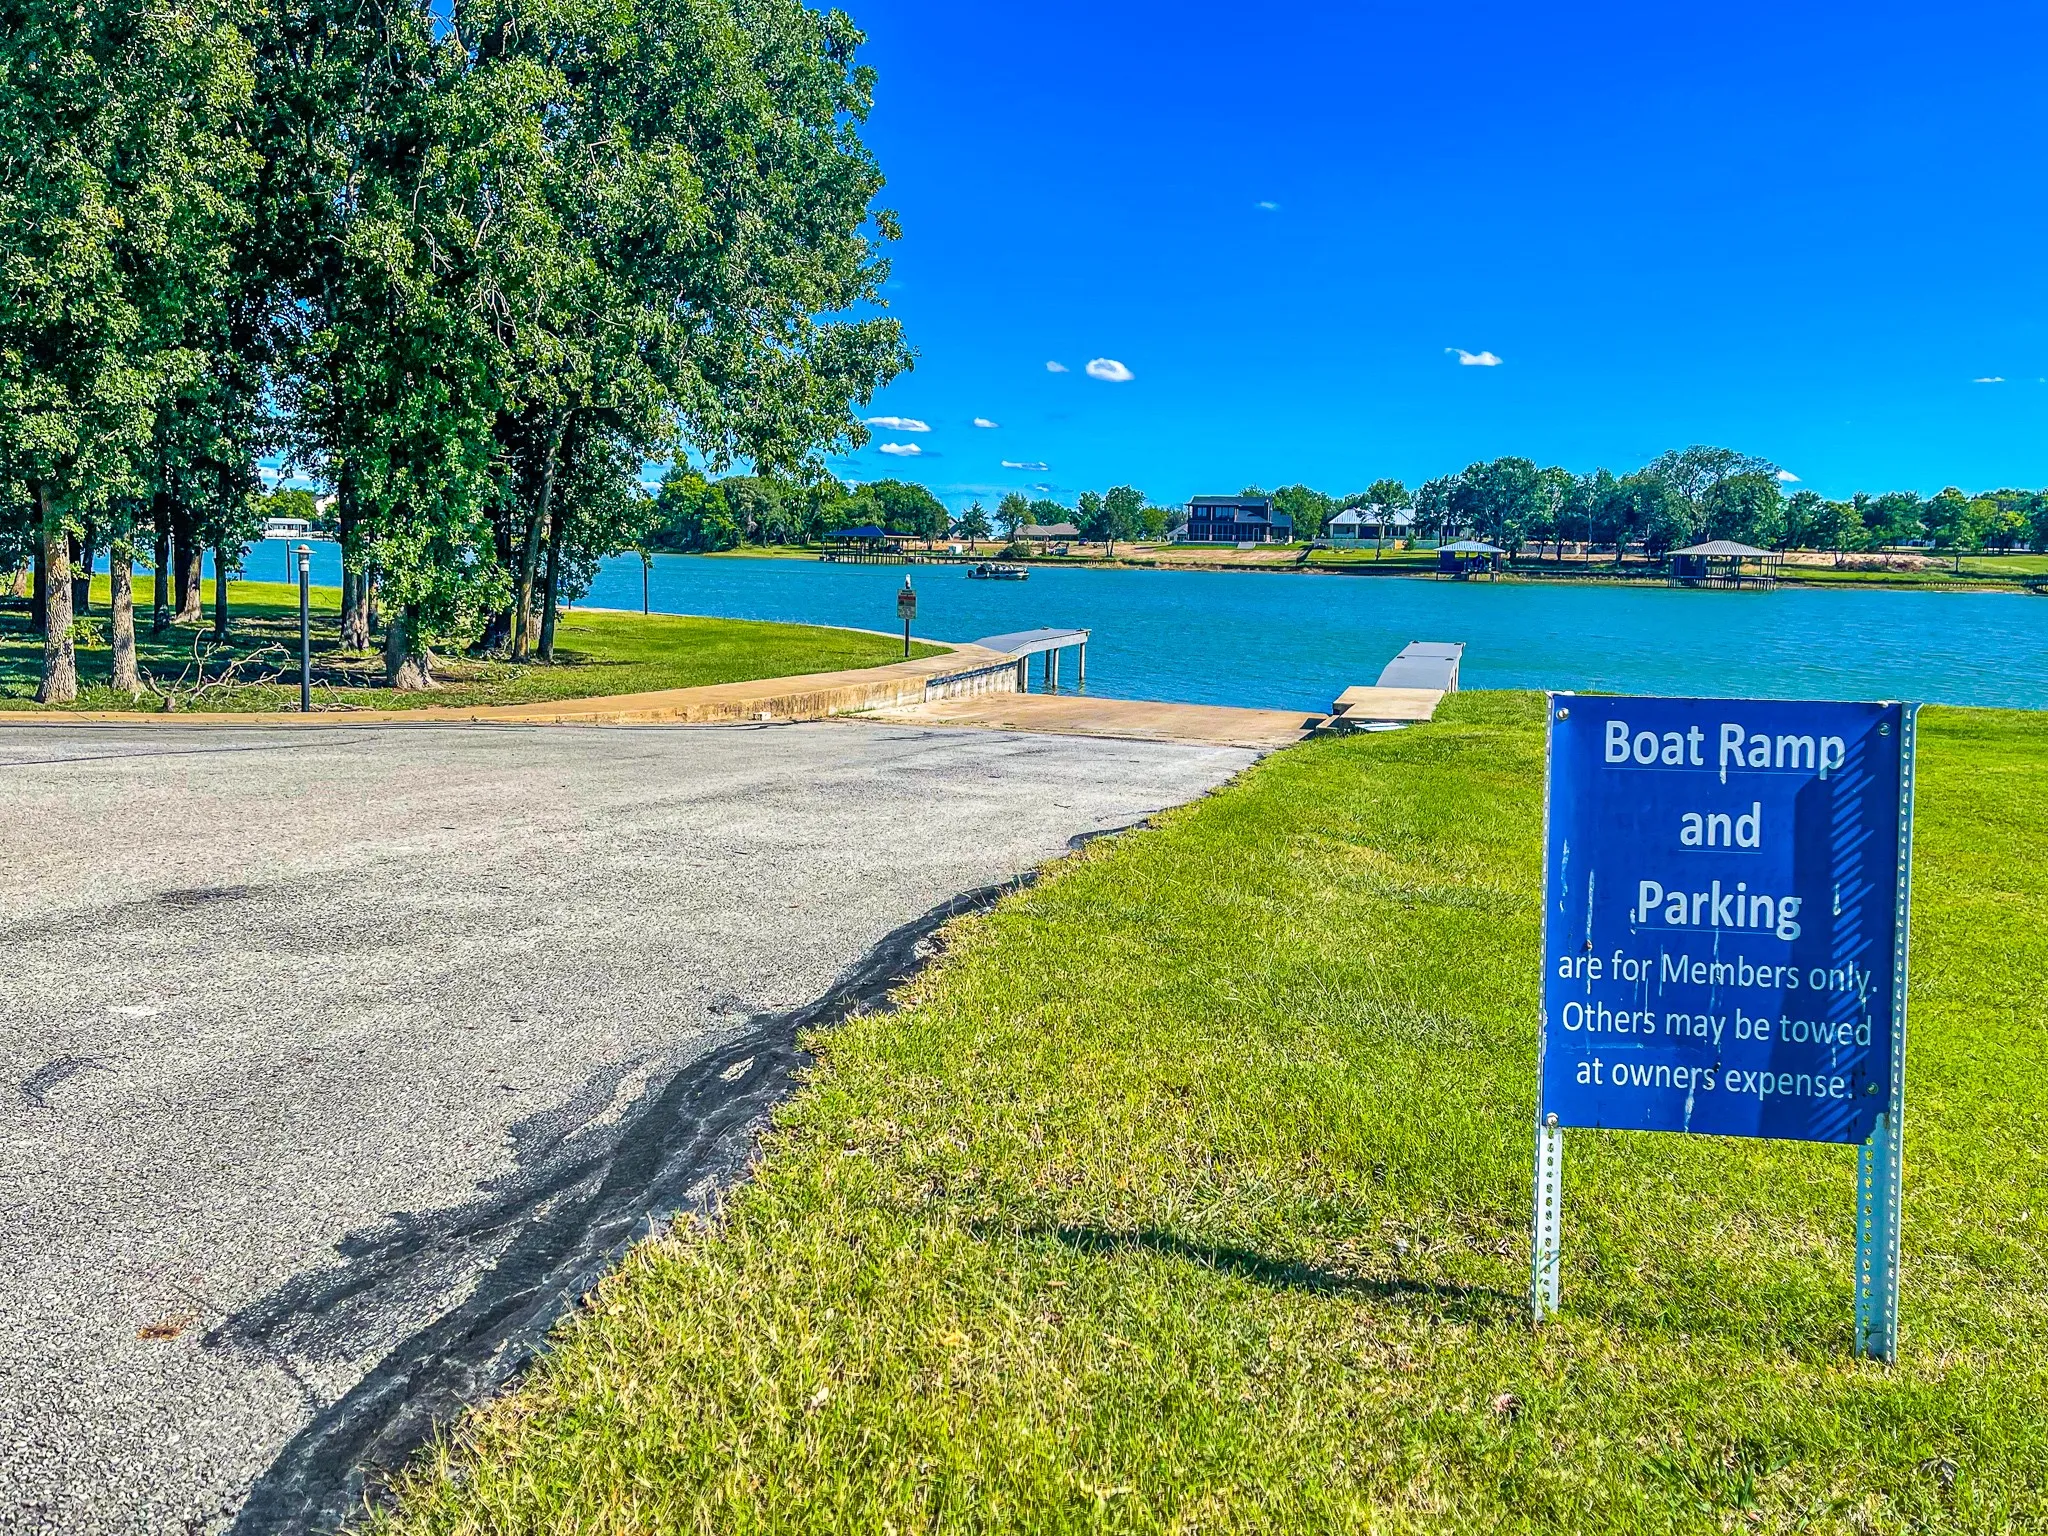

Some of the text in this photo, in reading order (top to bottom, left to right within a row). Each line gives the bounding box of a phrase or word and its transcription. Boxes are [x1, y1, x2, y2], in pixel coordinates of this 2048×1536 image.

[1605, 720, 1846, 781] Boat Ramp
[1679, 801, 1762, 849] and
[1638, 880, 1802, 941] Parking
[1558, 950, 1878, 1001] are for Members only.
[1562, 1001, 1872, 1047] Others may be towed
[1576, 1058, 1604, 1085] at
[1725, 1069, 1853, 1101] expense.
